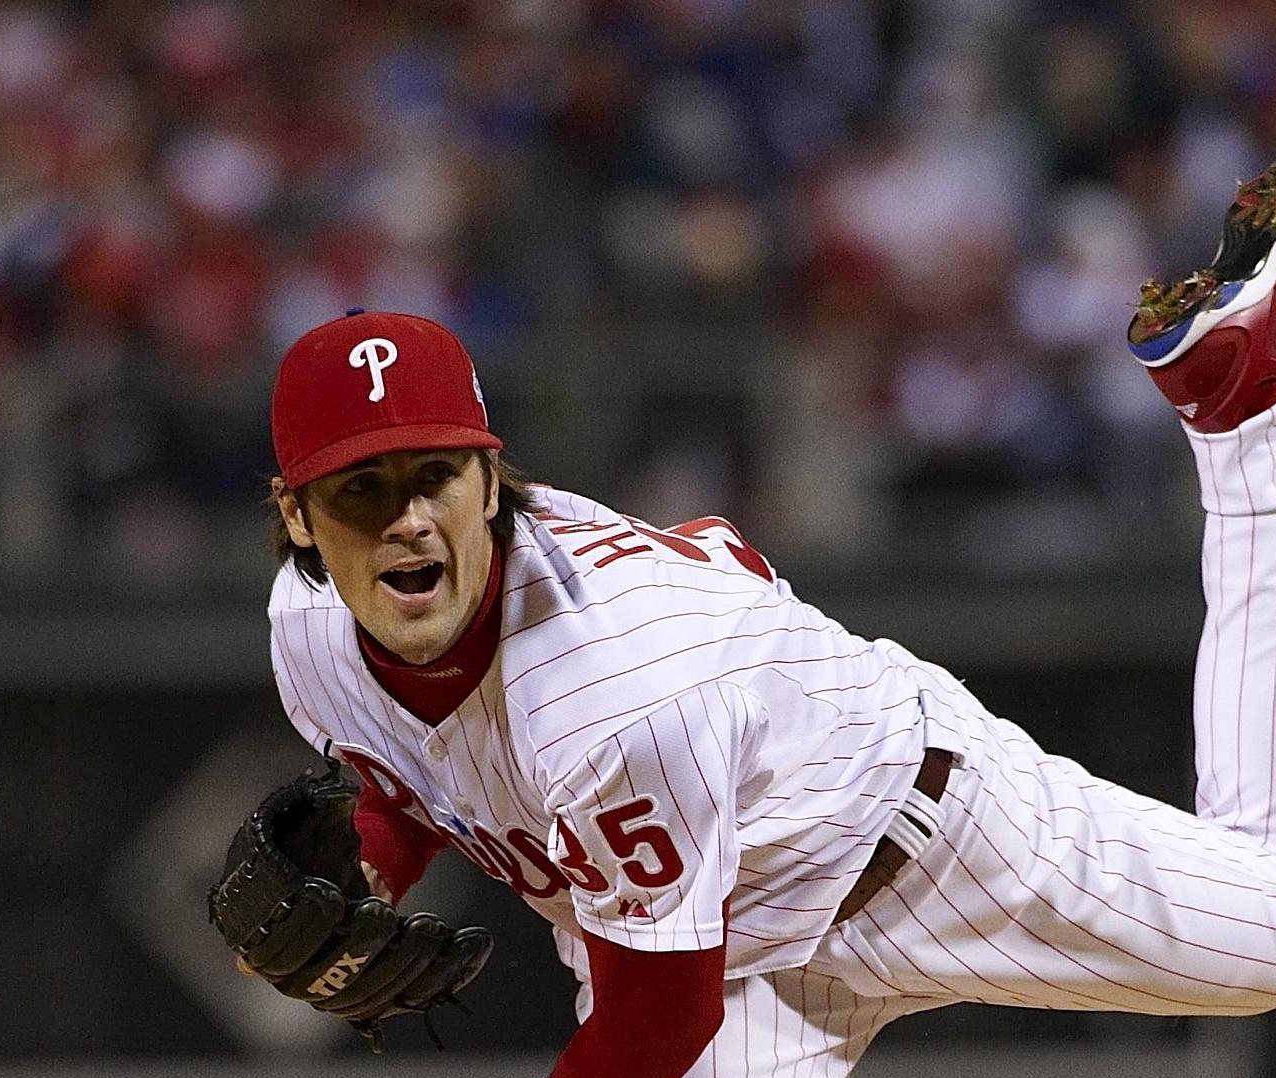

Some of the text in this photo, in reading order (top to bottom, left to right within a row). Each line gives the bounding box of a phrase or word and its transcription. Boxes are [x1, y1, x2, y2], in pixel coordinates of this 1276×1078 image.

[349, 338, 398, 402] P
[555, 796, 685, 893] 35
[306, 951, 370, 997] TPX
